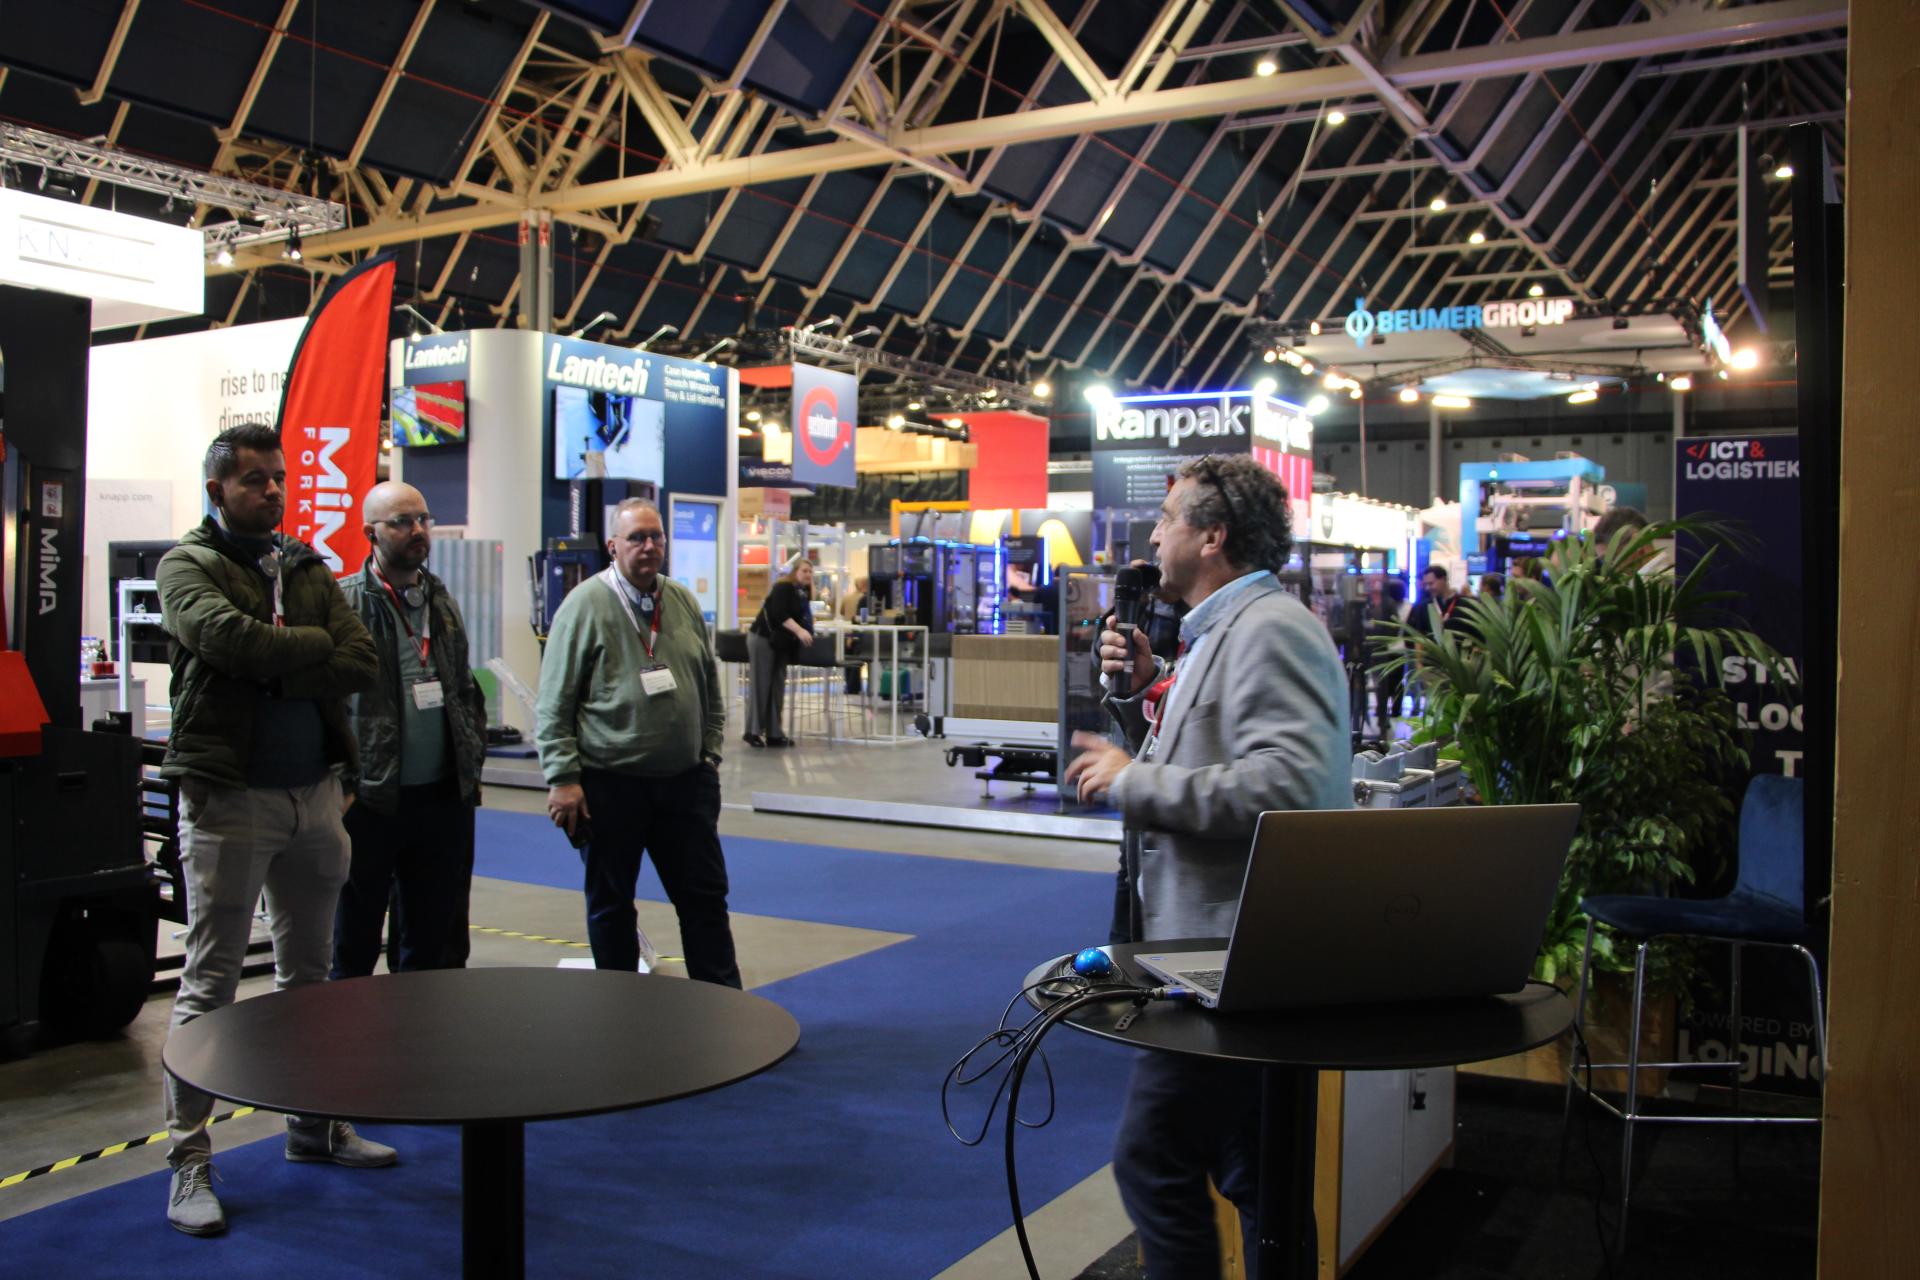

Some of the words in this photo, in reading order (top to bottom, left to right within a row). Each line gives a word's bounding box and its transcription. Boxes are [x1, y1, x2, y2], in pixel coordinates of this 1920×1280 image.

[404, 340, 468, 370] Lantech
[547, 342, 649, 396] Lantech
[220, 369, 247, 397] rise
[253, 368, 265, 393] to
[1095, 398, 1246, 447] Ranpak
[1686, 461, 1800, 480] LOGISTIEK
[99, 491, 153, 504] knapp.com
[39, 528, 61, 616] MiMA
[1789, 1021, 1815, 1039] BY
